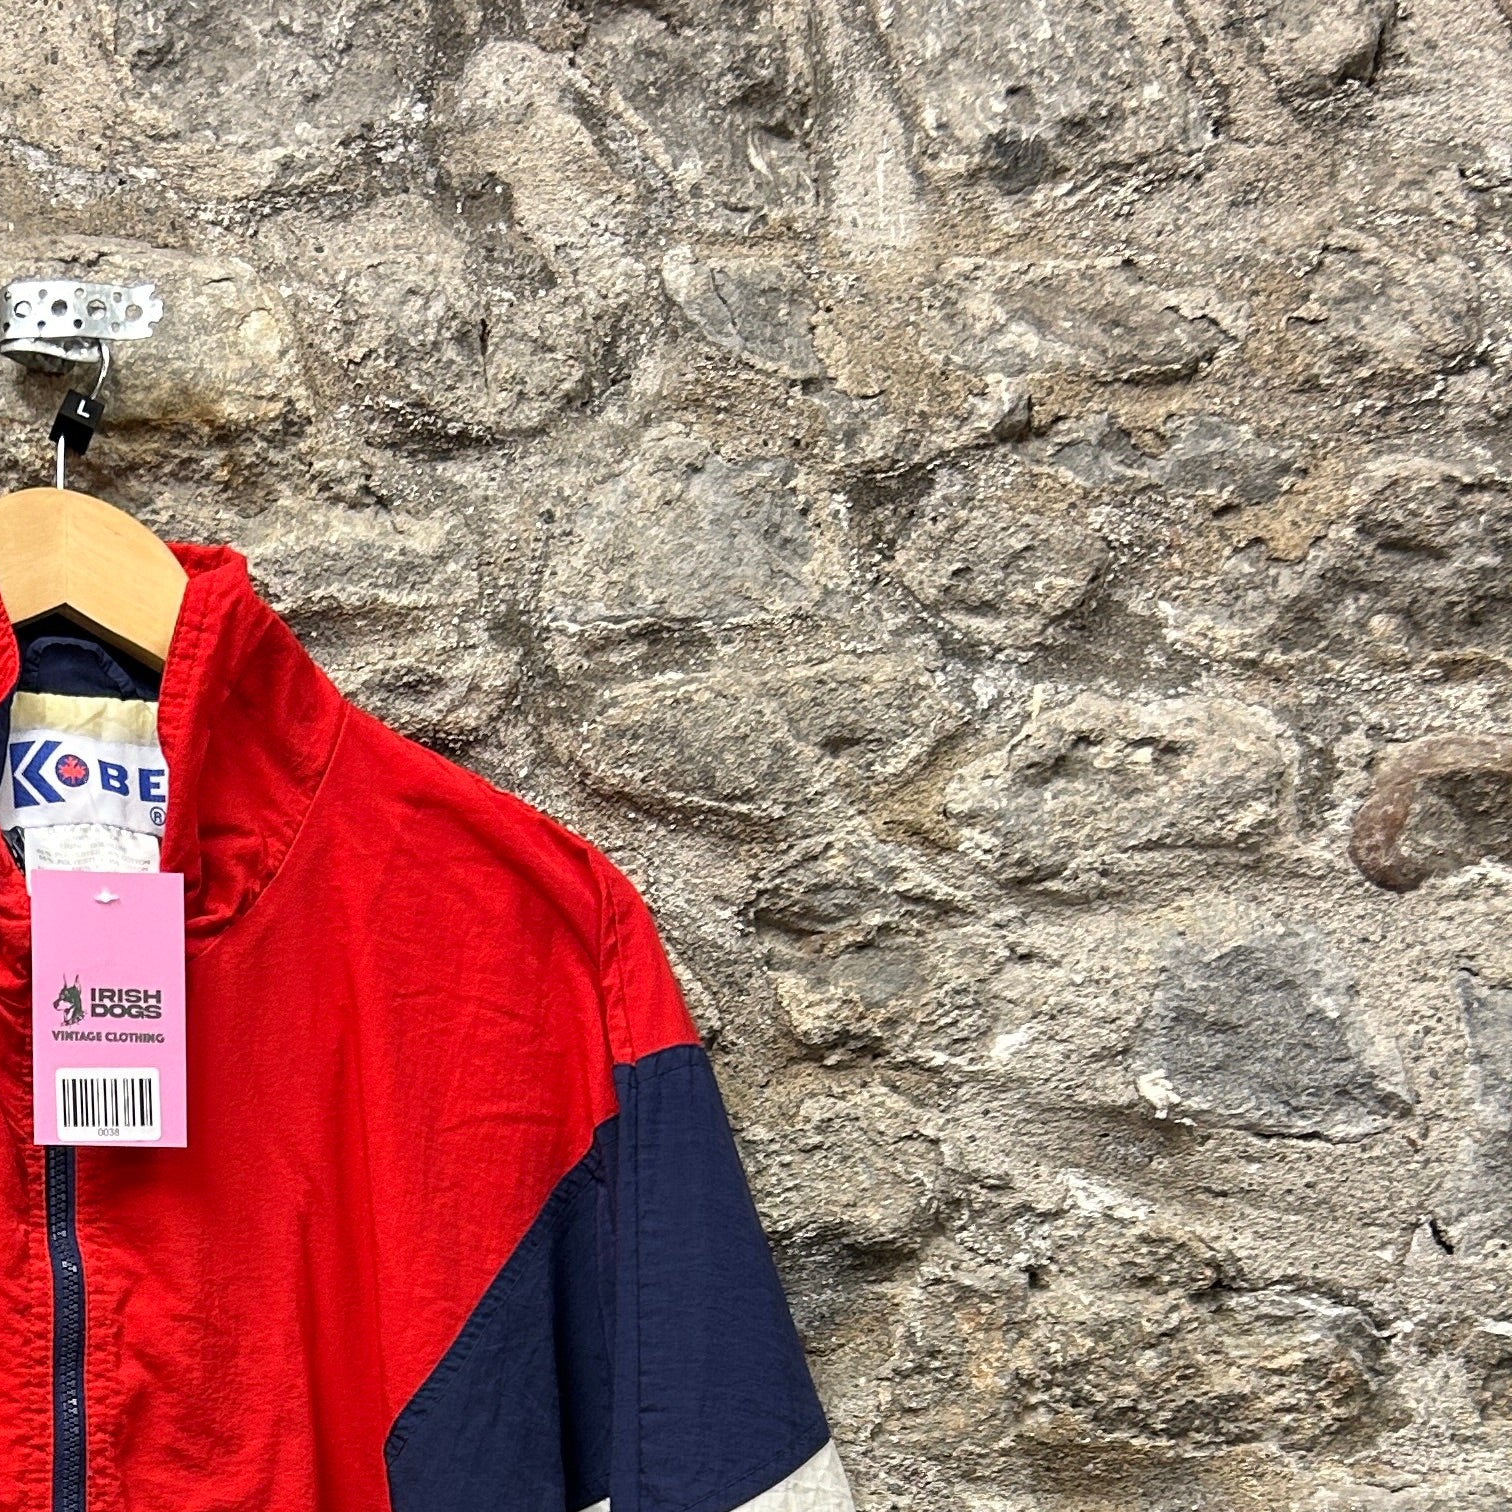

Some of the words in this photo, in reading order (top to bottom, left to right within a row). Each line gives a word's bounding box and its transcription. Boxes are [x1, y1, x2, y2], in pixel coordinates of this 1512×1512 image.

[77, 400, 90, 418] L
[9, 740, 166, 809] KOBE
[90, 988, 162, 1004] IRISH
[91, 1003, 162, 1019] DOGS
[52, 1030, 102, 1042] VINTAGE
[105, 1031, 165, 1043] CLOTHING
[97, 1127, 120, 1137] 0038
